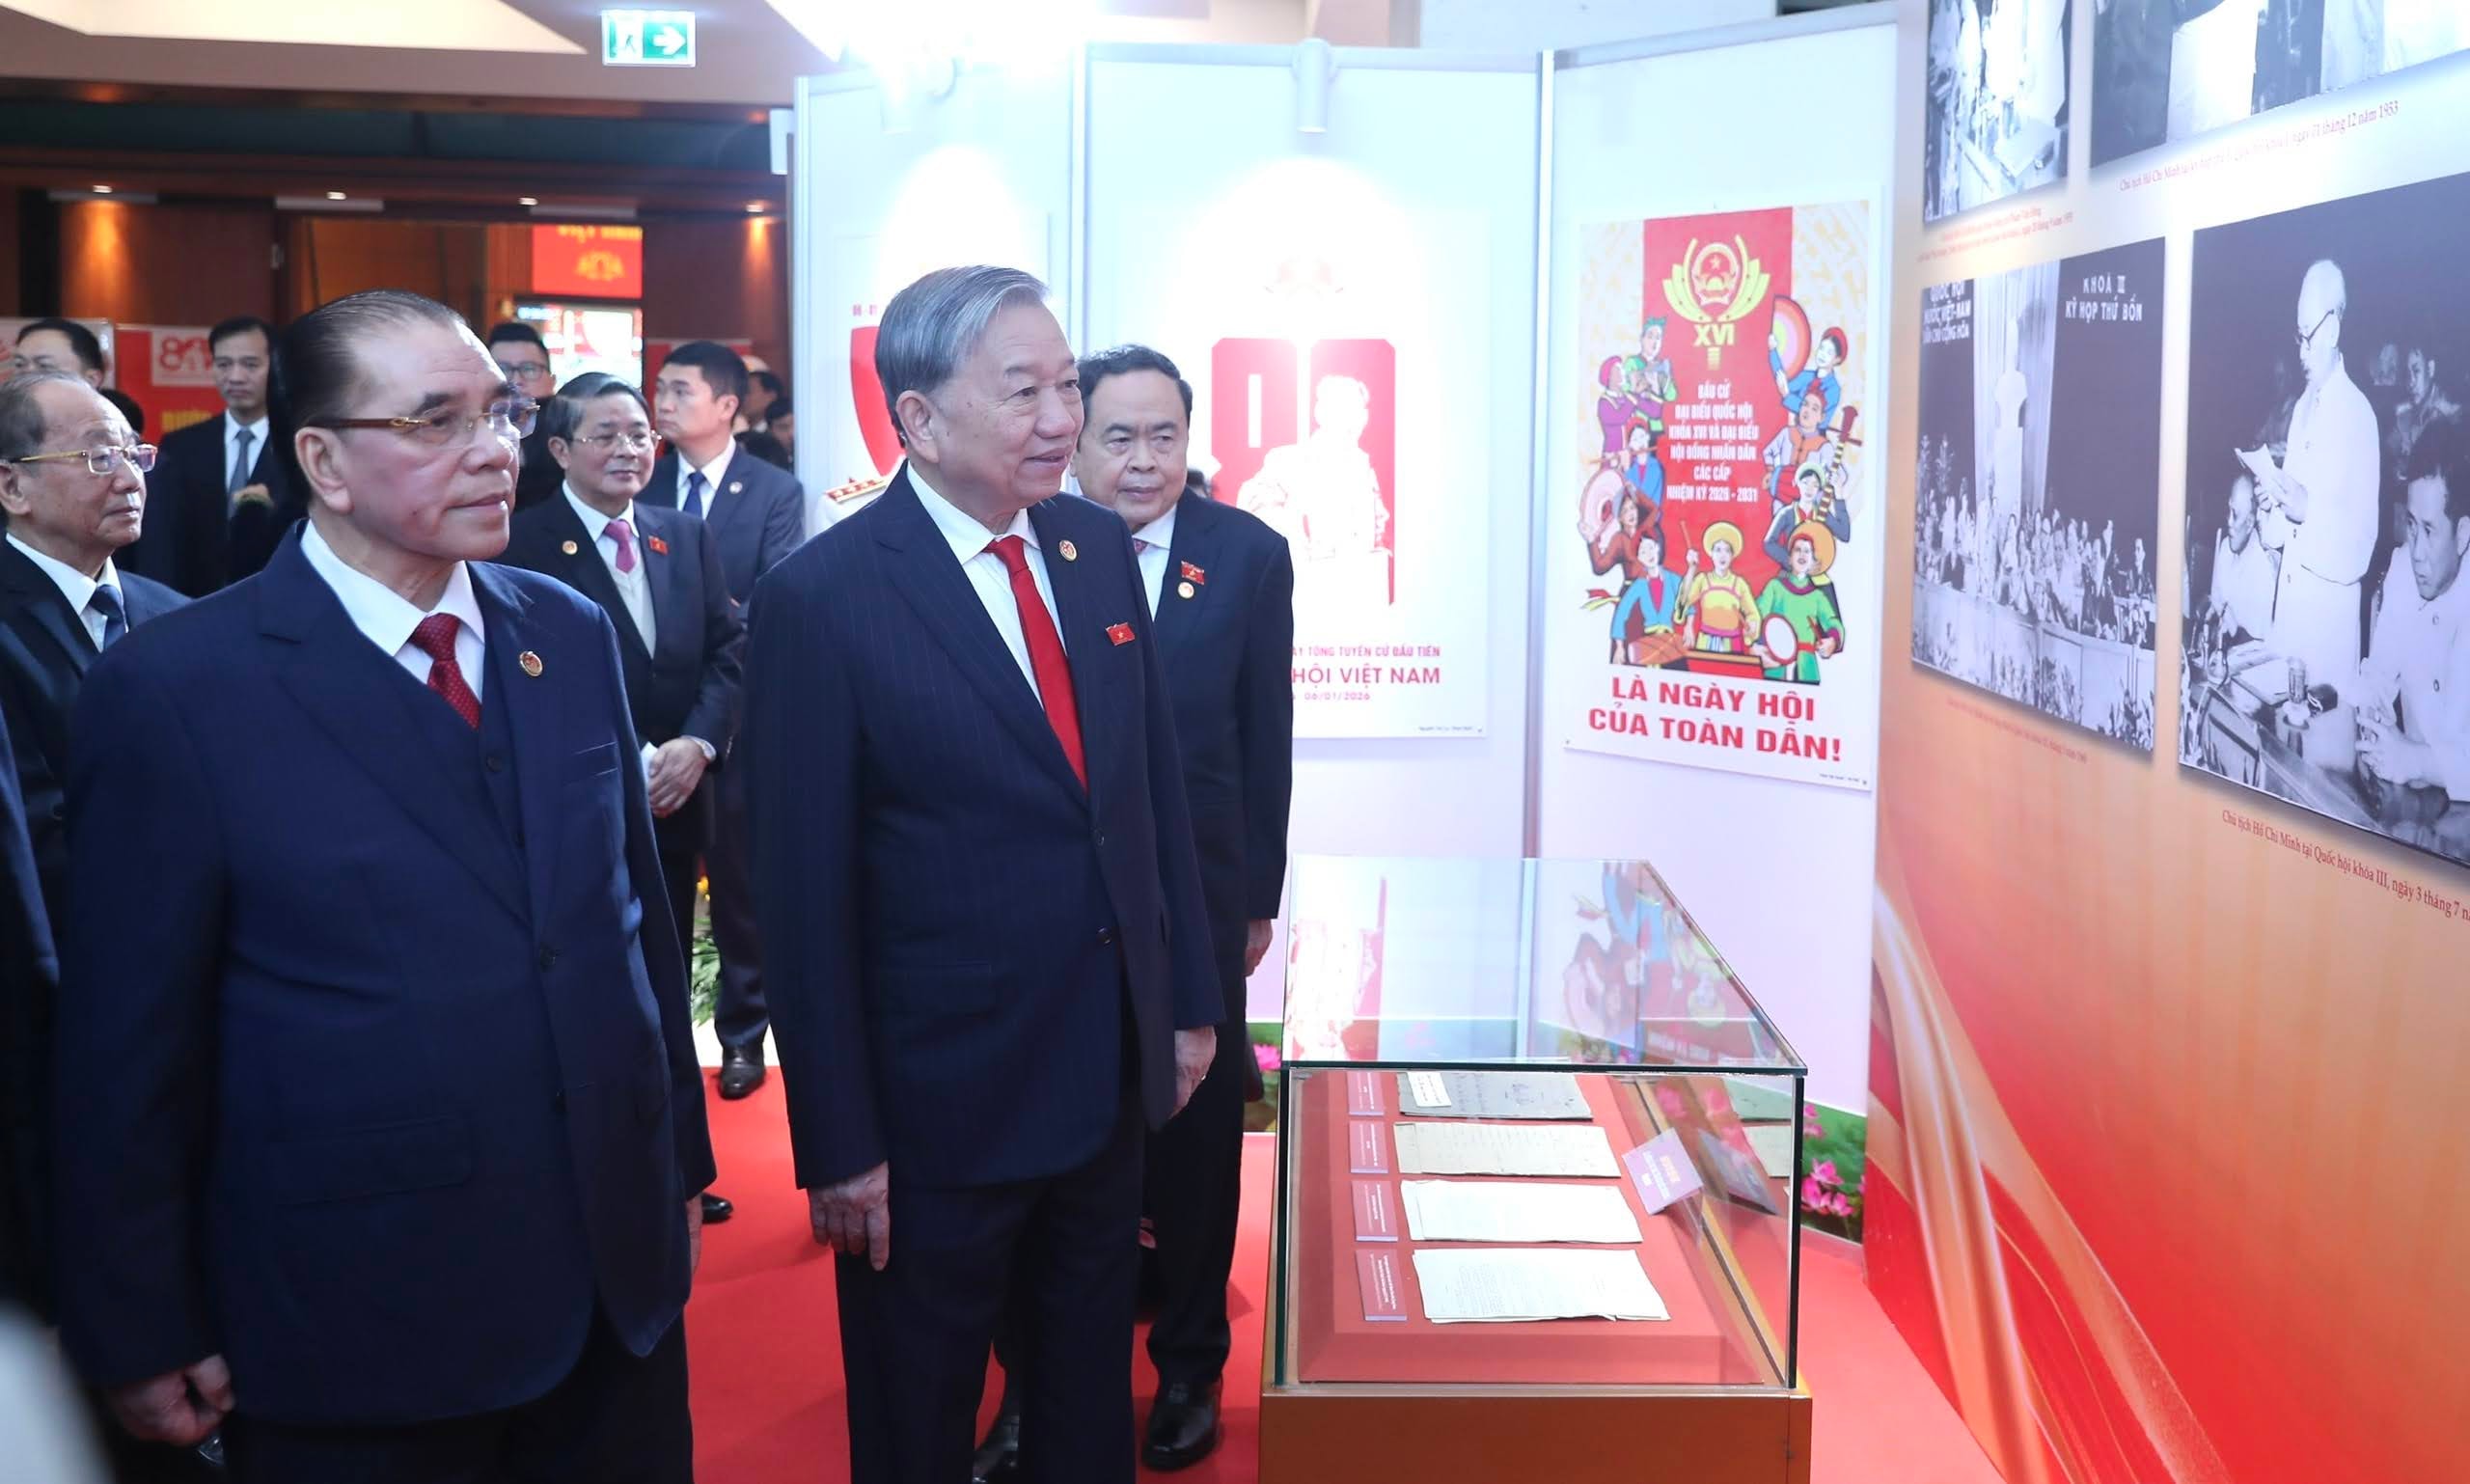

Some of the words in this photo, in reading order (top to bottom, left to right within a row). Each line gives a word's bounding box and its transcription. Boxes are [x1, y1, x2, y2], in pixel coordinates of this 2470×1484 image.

[2378, 100, 2399, 119] 1953
[2079, 301, 2099, 324] HỌP
[2100, 294, 2119, 320] THỨ
[2122, 293, 2143, 321] BỐN
[1693, 323, 1735, 346] XVI
[1292, 663, 1331, 689] HỘI
[1339, 663, 1383, 689] VIỆT
[1390, 667, 1441, 684] NAM
[1612, 673, 1648, 701] LÀ
[1659, 681, 1745, 712] NGÀY
[1758, 689, 1816, 726] HỘI
[1588, 701, 1649, 736] CỦA
[1659, 717, 1744, 749] TOÀN
[1756, 727, 1842, 762] DÂN!
[2222, 810, 2237, 826] Chủ
[2253, 820, 2264, 837] Hồ
[2264, 826, 2278, 842] Chí
[2280, 831, 2301, 853] Minh
[2302, 842, 2313, 860] tại
[2314, 845, 2336, 866] Quốc
[2337, 853, 2351, 874] hội
[2376, 869, 2390, 891] III,
[2392, 879, 2414, 903] ngày
[2416, 886, 2423, 902] 3
[2424, 890, 2452, 919] tháng
[2454, 900, 2460, 917] 7
